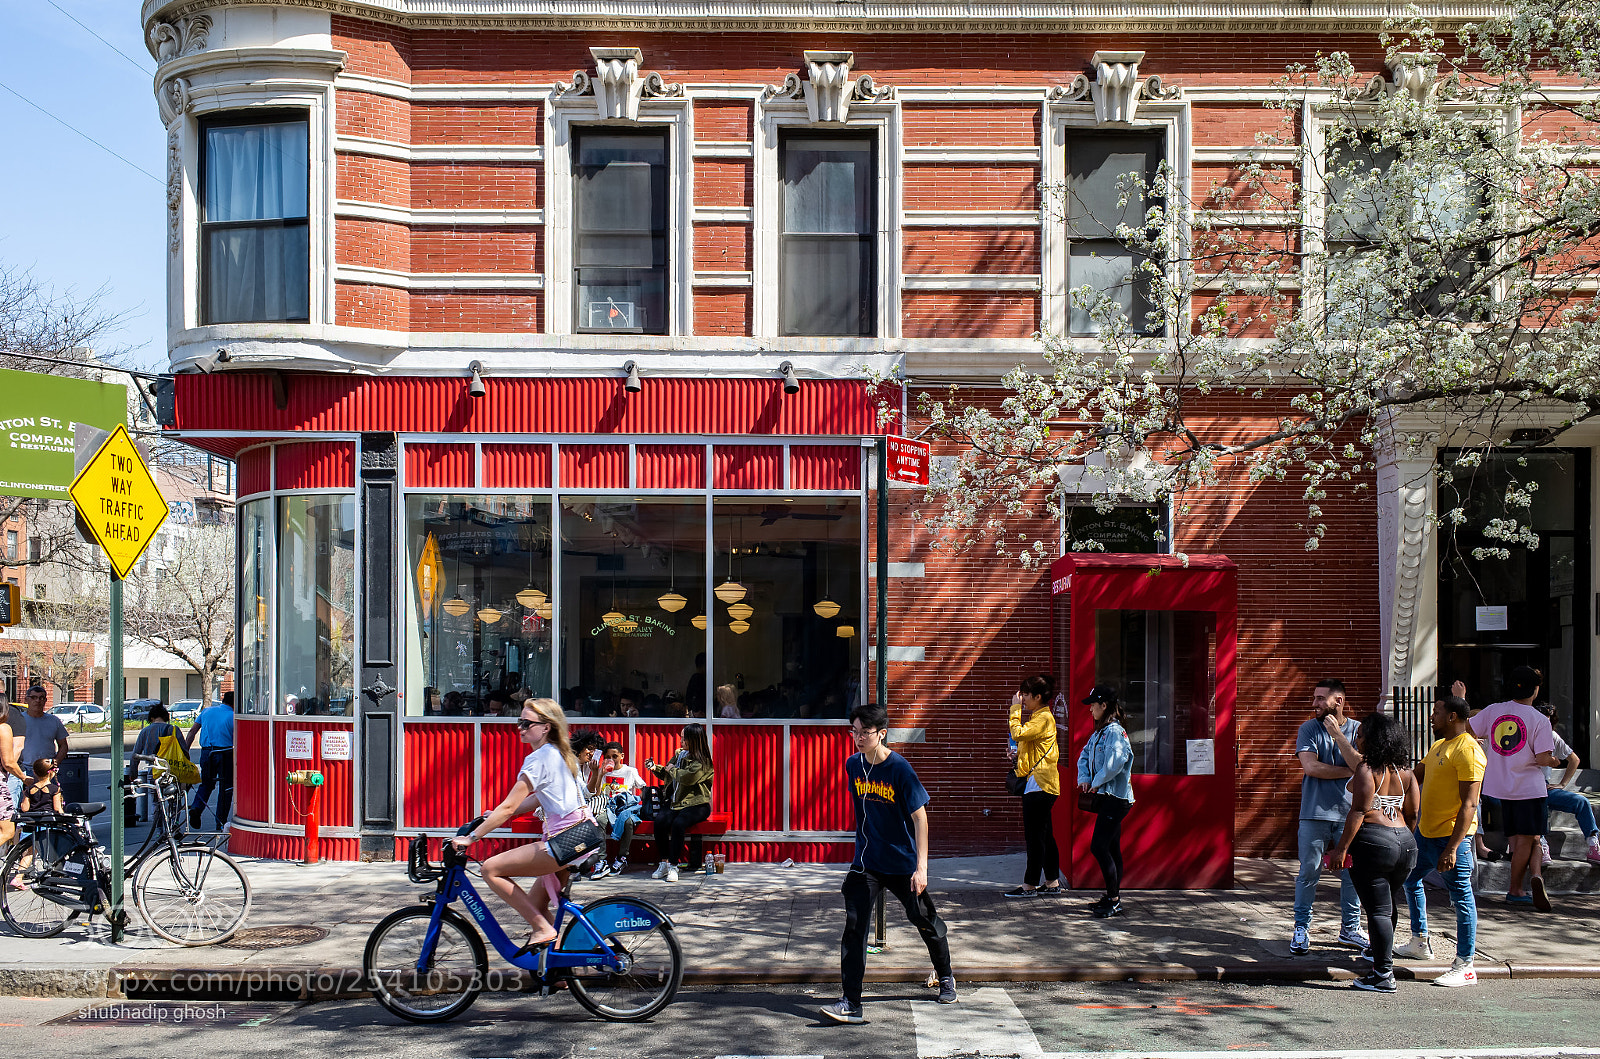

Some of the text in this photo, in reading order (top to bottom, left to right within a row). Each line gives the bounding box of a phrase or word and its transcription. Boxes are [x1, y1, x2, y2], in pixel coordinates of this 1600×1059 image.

[9, 432, 74, 447] COMPAN
[20, 442, 76, 454] RESTAURAN
[890, 441, 927, 457] NO STOPPING
[110, 453, 133, 474] TWO
[896, 455, 921, 468] ANYTIME
[0, 481, 70, 493] CLINTONSTREET
[111, 476, 133, 496] WAY
[99, 497, 144, 521] TRAFFIC
[104, 521, 140, 542] AHEAD
[1119, 522, 1150, 542] BAKING
[590, 615, 627, 636] CLINTON
[644, 615, 676, 636] BAKING
